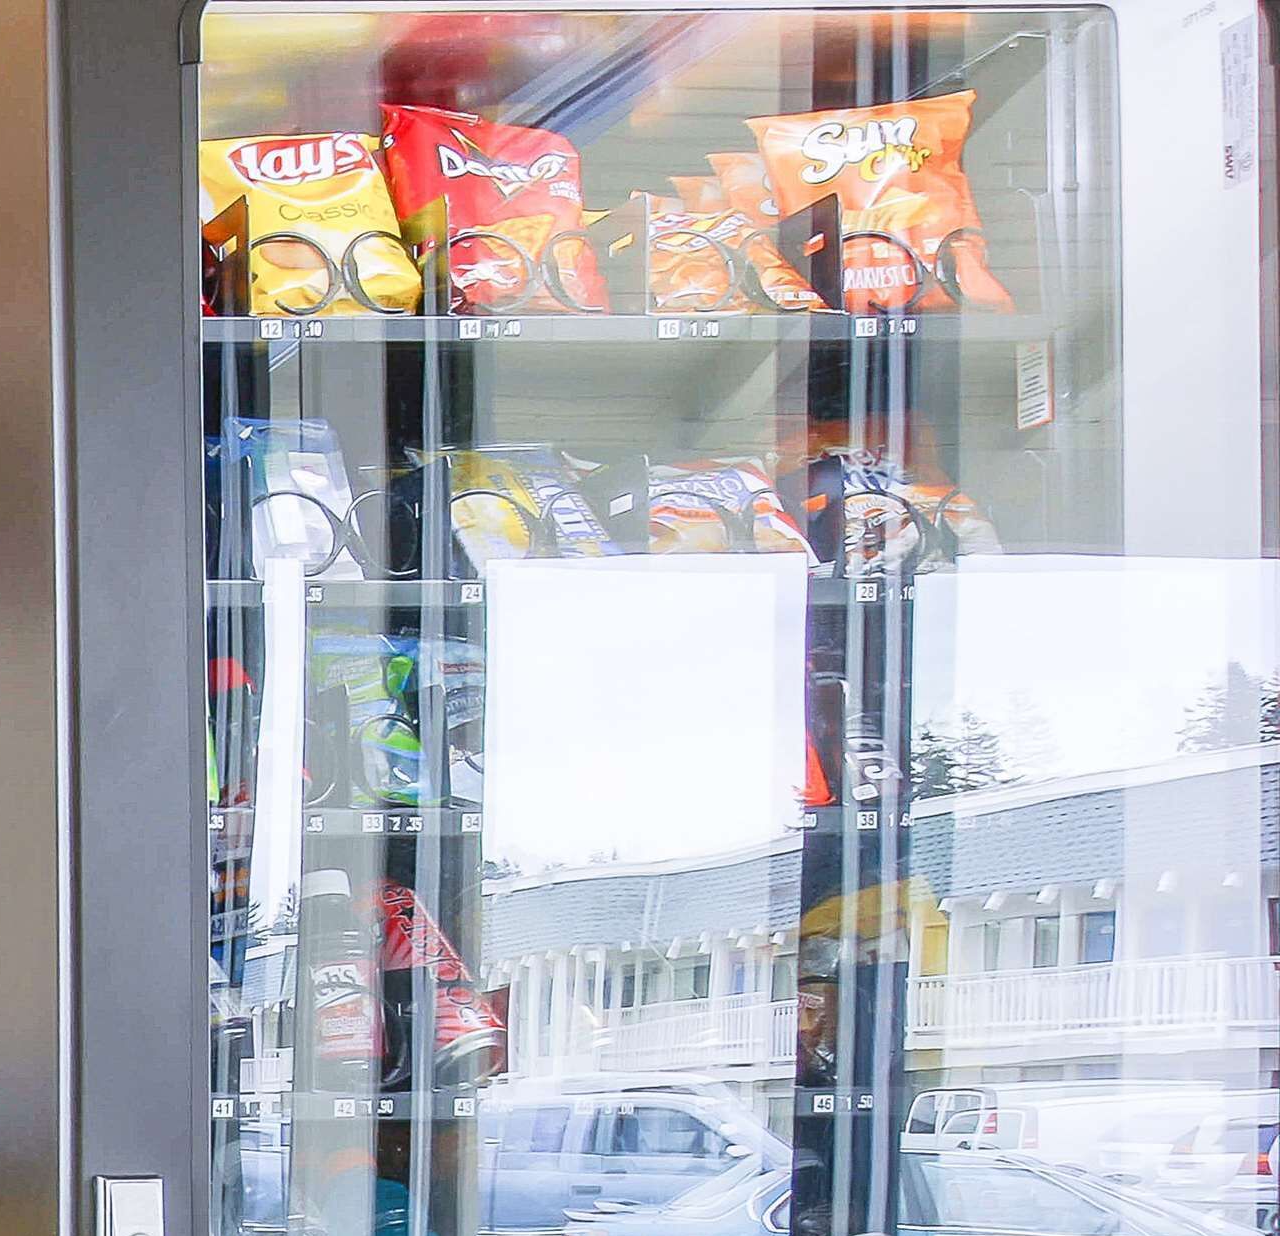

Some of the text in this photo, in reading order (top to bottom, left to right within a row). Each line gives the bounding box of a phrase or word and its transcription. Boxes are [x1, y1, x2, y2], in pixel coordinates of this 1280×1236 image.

[236, 133, 367, 181] Lay's
[800, 117, 917, 184] Sun
[262, 322, 280, 337] 12
[462, 322, 479, 337] 14
[660, 322, 678, 337] 16
[464, 586, 481, 600] 24
[859, 585, 875, 600] 28
[859, 814, 876, 827] 38
[215, 1101, 231, 1115] 41
[336, 1101, 353, 1115] 42
[456, 1101, 474, 1115] 43
